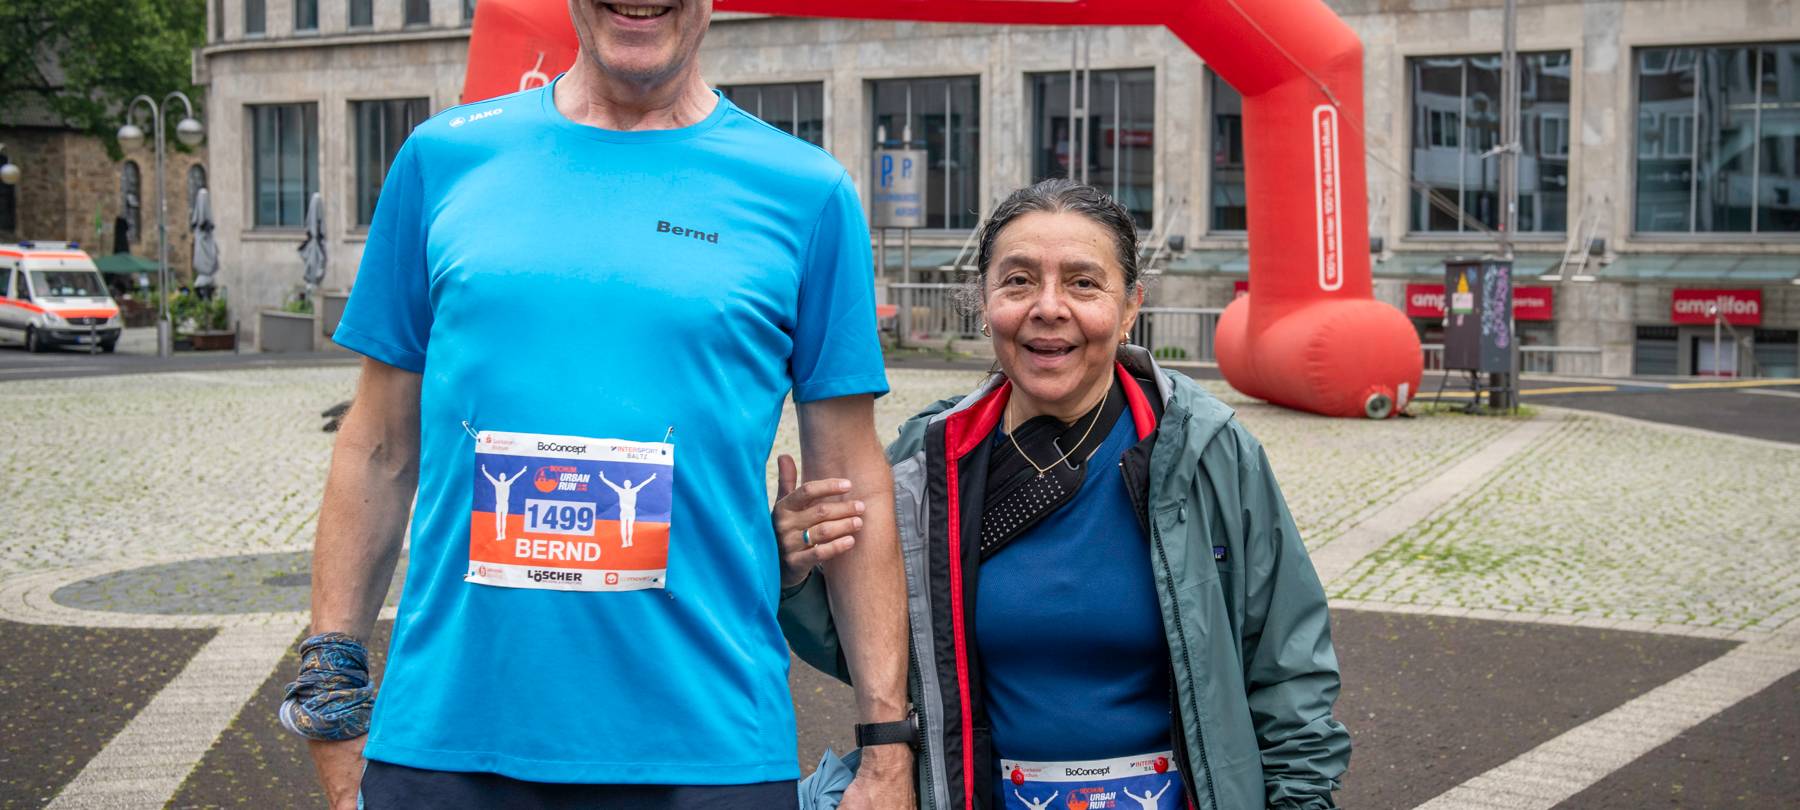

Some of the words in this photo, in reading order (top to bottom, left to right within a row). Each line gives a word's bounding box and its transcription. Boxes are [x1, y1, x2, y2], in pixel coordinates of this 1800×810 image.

[468, 108, 503, 121] JAKO
[656, 220, 719, 244] Bernd
[1675, 295, 1758, 317] amplifon
[537, 441, 587, 455] BoConcept
[560, 472, 590, 483] URBAN
[558, 481, 577, 491] RUN
[528, 503, 594, 531] 1499
[515, 538, 601, 562] BERND
[527, 569, 582, 582] LÖSCHER
[1065, 766, 1110, 776] BoConcept
[1090, 792, 1116, 801] URBAN
[1089, 800, 1106, 810] RUN
